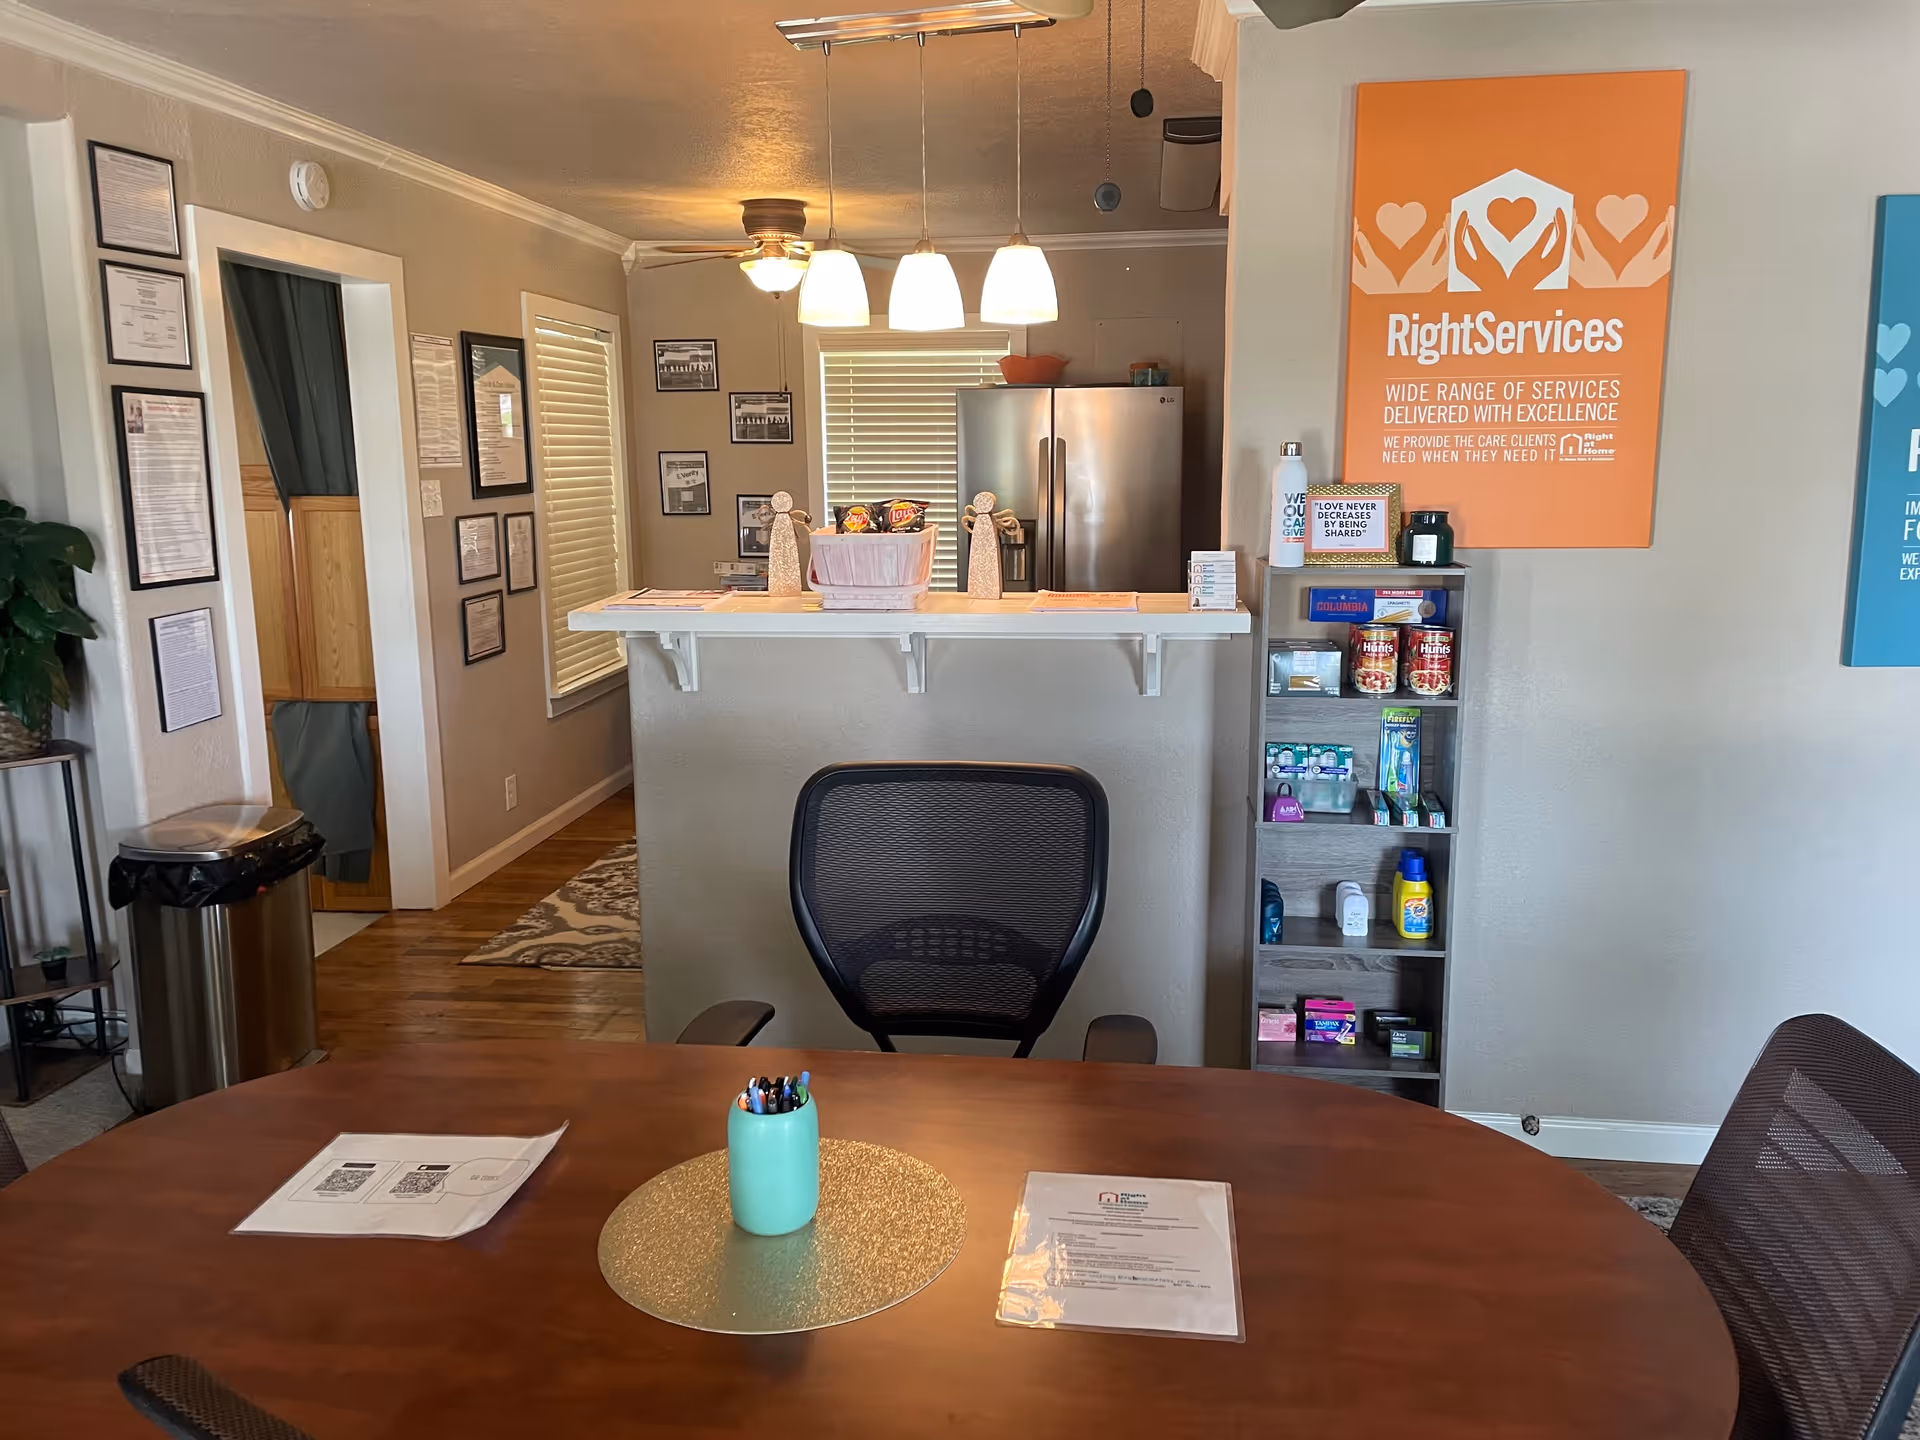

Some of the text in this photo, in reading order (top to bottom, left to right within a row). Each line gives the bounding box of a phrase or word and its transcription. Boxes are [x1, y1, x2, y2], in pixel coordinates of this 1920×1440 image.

[1387, 309, 1624, 365] RightServices
[1385, 380, 1620, 402] WIDE RANGE OF SERVICES
[1384, 402, 1619, 424] DELIVERED WITH EXCELLENCE
[1384, 433, 1556, 448] WE PROVIDE THE CARE CLIENTS
[1584, 433, 1614, 441] Right
[1382, 450, 1416, 463] NEED
[1422, 449, 1459, 463] WHEN
[1465, 449, 1497, 462] THEY
[1503, 449, 1538, 462] NEED
[1544, 448, 1556, 461] IT
[1284, 492, 1305, 504] WE
[1283, 504, 1305, 518] OU
[1315, 502, 1377, 511] "LOVE NEVER
[1317, 511, 1371, 520] DECREASES
[1324, 520, 1367, 529] BY BEING
[1325, 529, 1367, 537] SHARED"
[1316, 601, 1368, 612] COLUMBIA
[1363, 641, 1394, 654] Hunt's
[1420, 643, 1451, 655] Hunt's
[1387, 716, 1416, 724] FIREFLY
